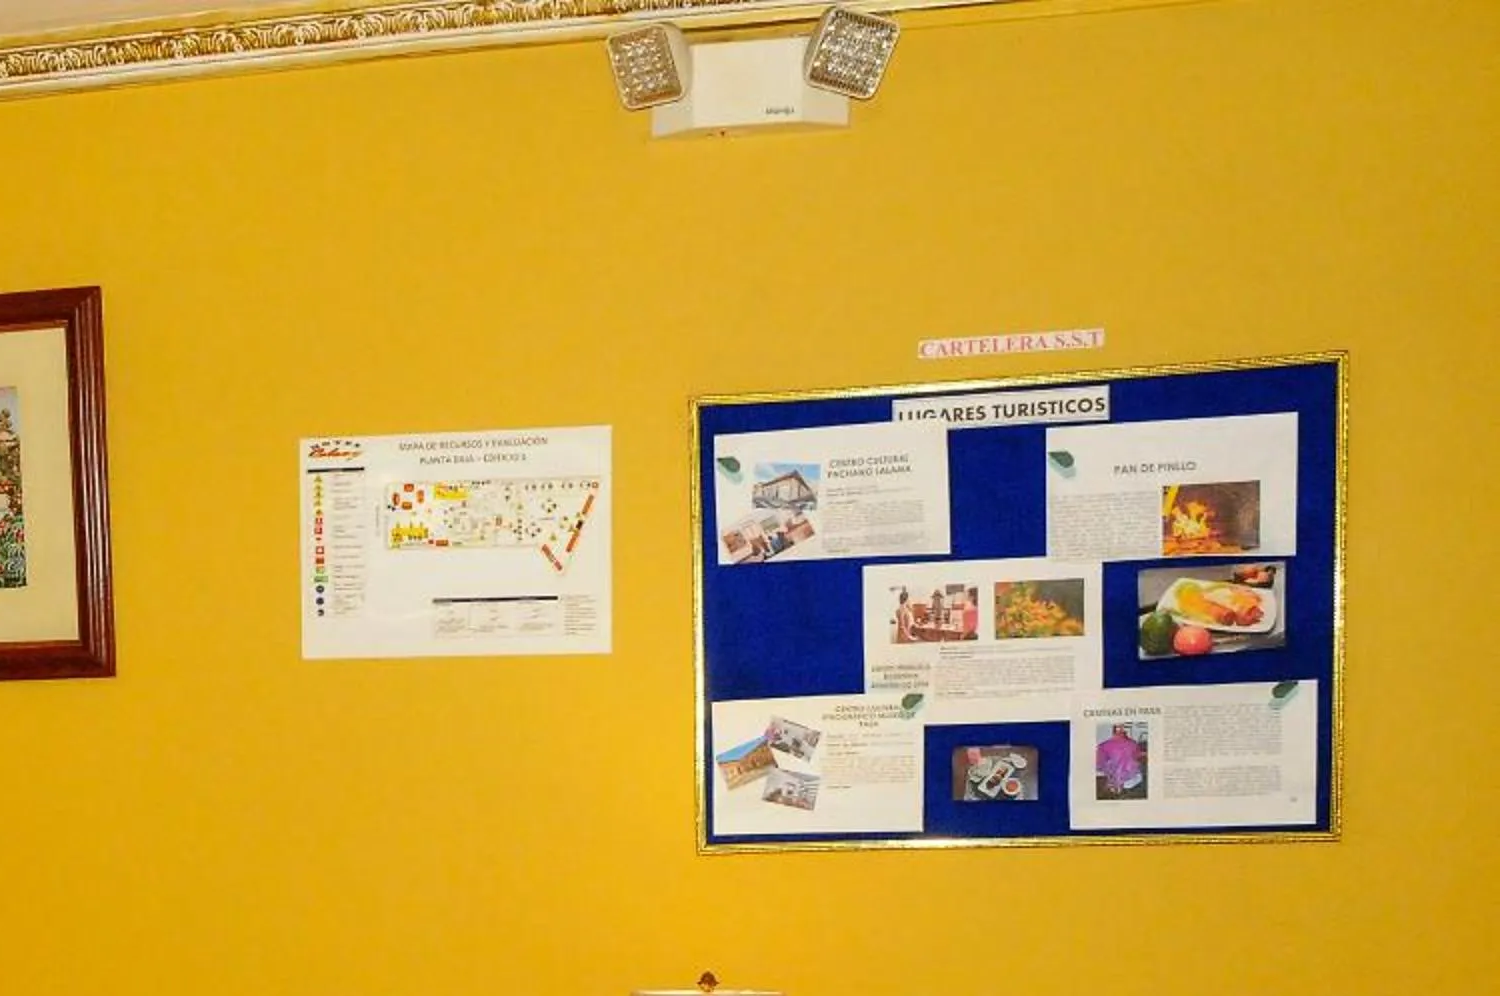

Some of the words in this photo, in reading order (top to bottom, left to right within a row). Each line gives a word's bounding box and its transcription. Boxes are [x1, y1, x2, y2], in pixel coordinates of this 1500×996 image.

[920, 335, 1048, 357] CARTELERA
[991, 397, 1106, 420] TURISTICOS
[1113, 463, 1138, 475] PAN
[1140, 463, 1156, 474] DE
